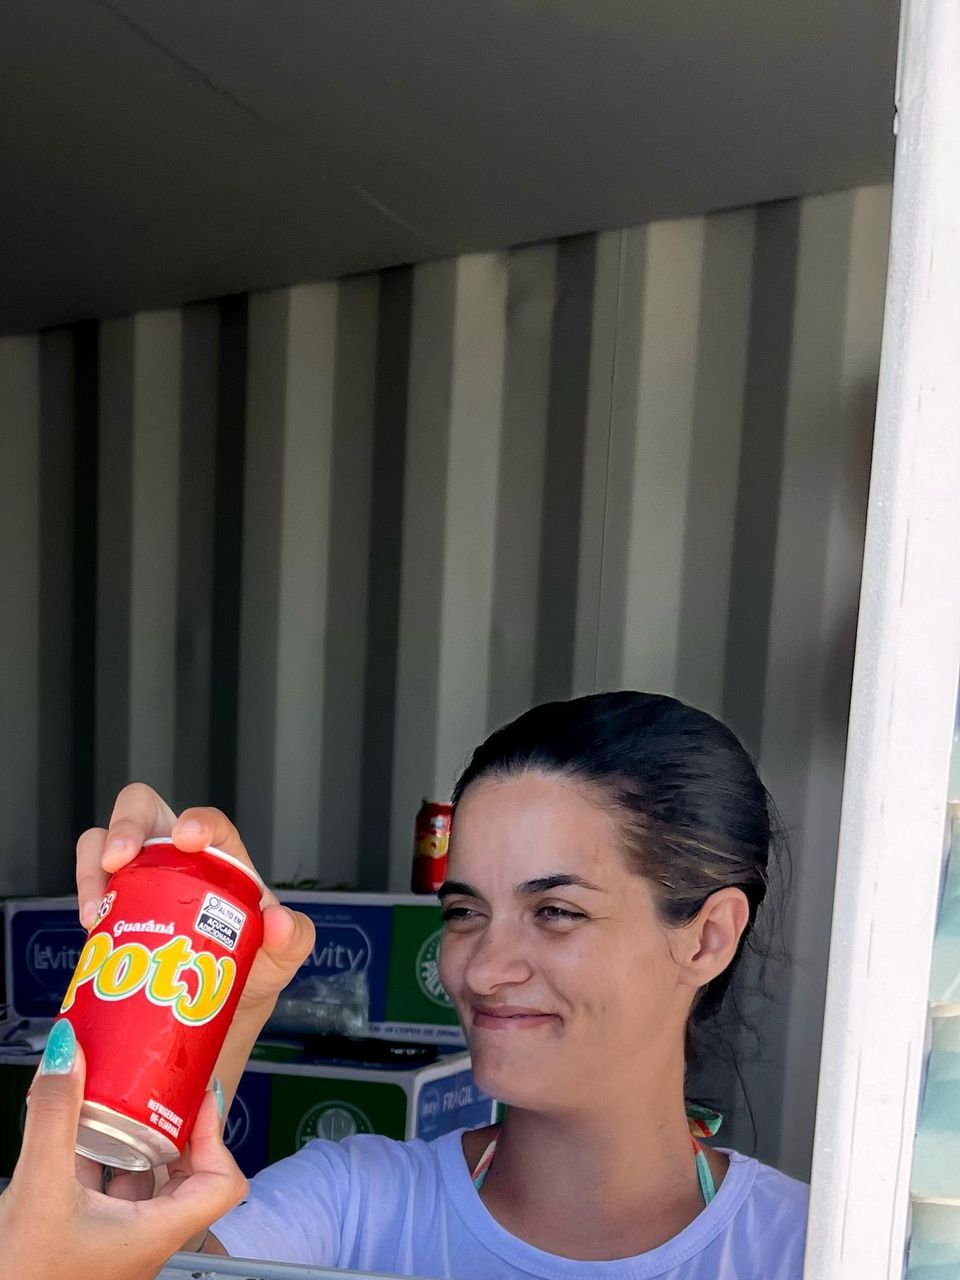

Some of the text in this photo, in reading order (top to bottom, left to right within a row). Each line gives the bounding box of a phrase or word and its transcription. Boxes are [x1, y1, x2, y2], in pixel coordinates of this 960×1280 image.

[218, 906, 234, 919] ALTO
[113, 920, 175, 937] Guaraná
[198, 922, 234, 947] ADICIONADO
